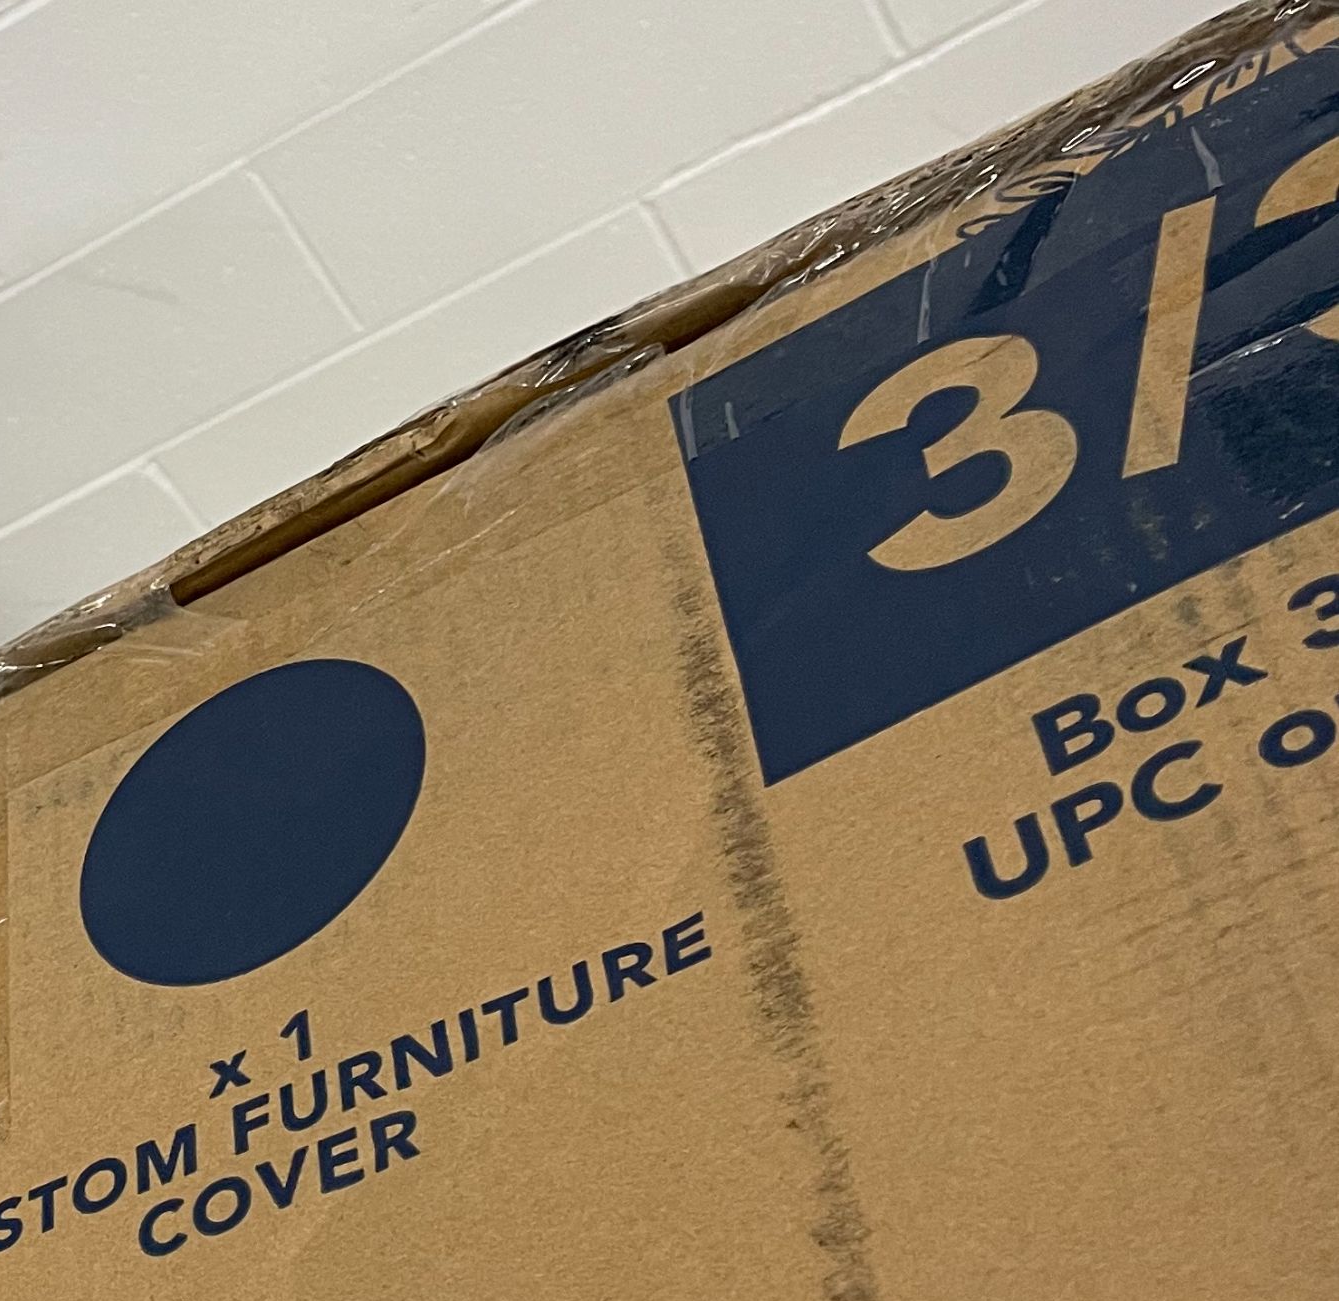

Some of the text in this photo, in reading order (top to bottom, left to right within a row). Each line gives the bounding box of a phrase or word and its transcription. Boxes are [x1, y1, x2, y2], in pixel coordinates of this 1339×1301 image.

[1030, 634, 1269, 777] Box
[962, 693, 1339, 900] UPC o
[208, 1009, 312, 1099] x 1
[232, 911, 714, 1155] FURNITURE
[137, 1109, 422, 1258] COVER
